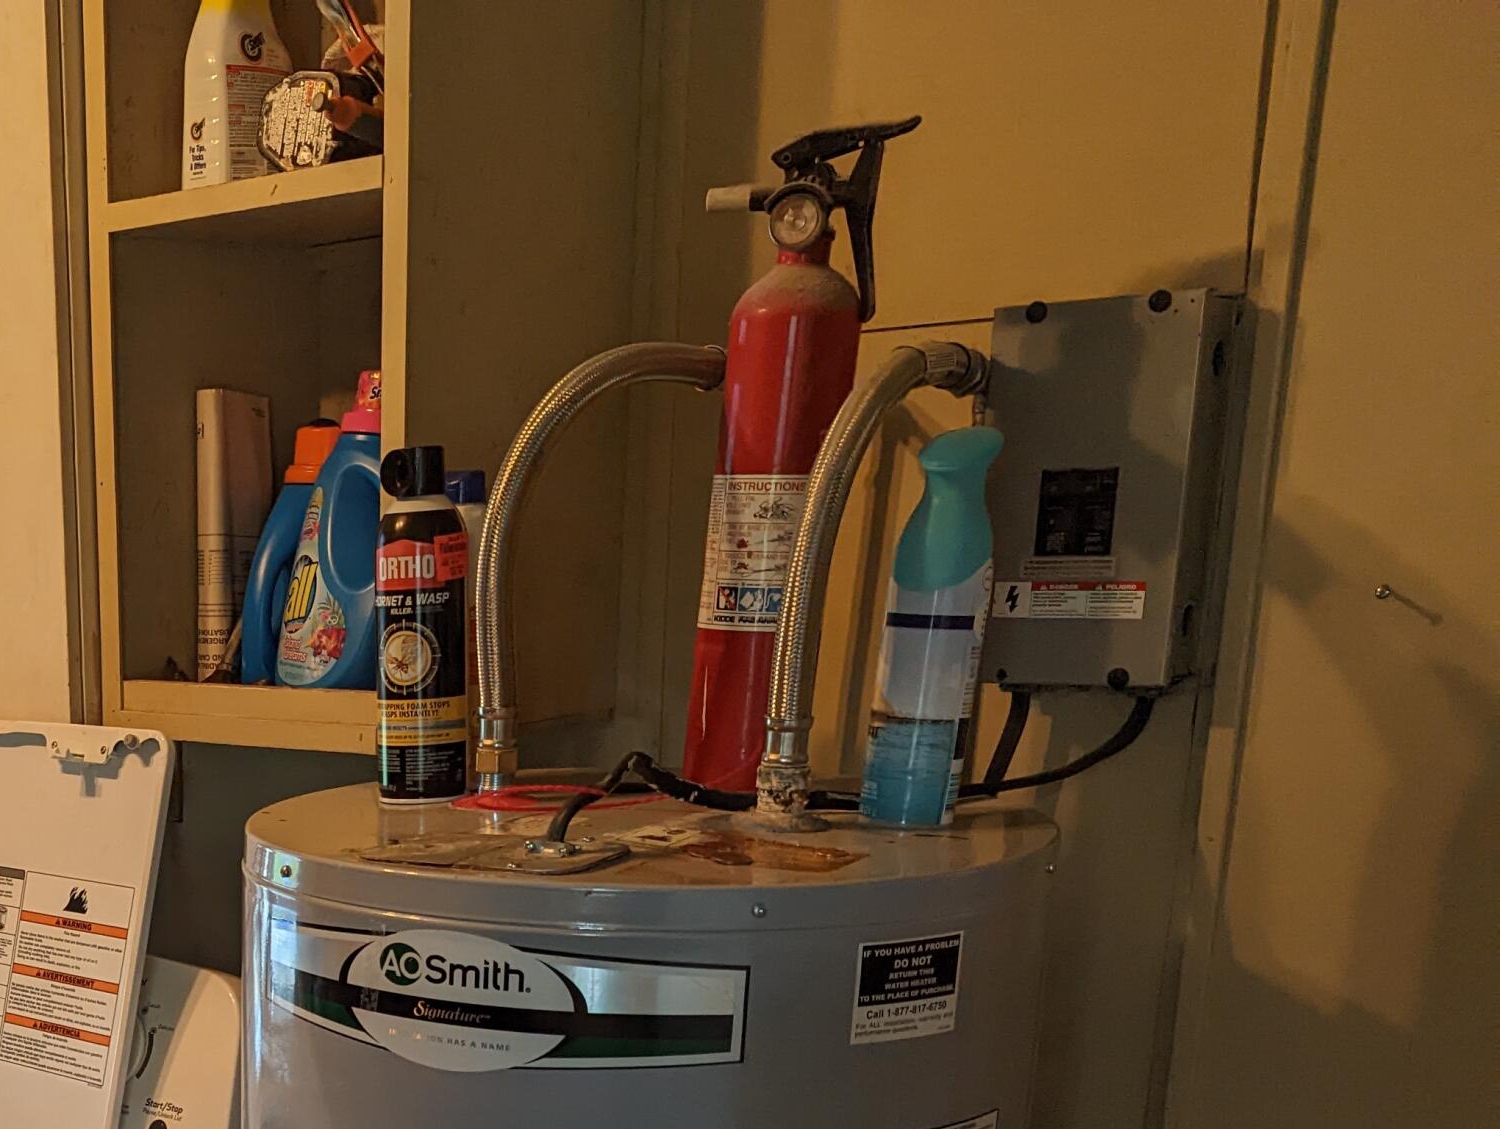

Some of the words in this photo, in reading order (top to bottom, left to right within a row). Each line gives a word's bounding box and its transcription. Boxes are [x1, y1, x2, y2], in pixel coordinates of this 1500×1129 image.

[379, 554, 435, 582] ORTHO
[284, 561, 318, 623] all
[375, 595, 405, 607] ORNET
[416, 592, 451, 606] WASP
[61, 918, 92, 931] WARNING
[863, 950, 872, 958] IF
[874, 948, 892, 957] YOU
[894, 945, 916, 955] HAVE
[925, 939, 960, 951] PROBLEM
[894, 959, 909, 969] DO
[911, 956, 933, 966] NOT
[41, 970, 95, 989] AVERTISSEMENT
[889, 970, 918, 980] RETURN
[919, 968, 935, 976] THIS
[884, 980, 909, 990] WATER
[910, 977, 937, 987] HEATER
[887, 991, 910, 1000] PLACE
[413, 1000, 485, 1024] Signature
[866, 1010, 885, 1020] Call
[447, 1039, 465, 1047] HAS
[481, 1042, 511, 1051] NAME
[145, 1098, 183, 1114] Start/Stop
